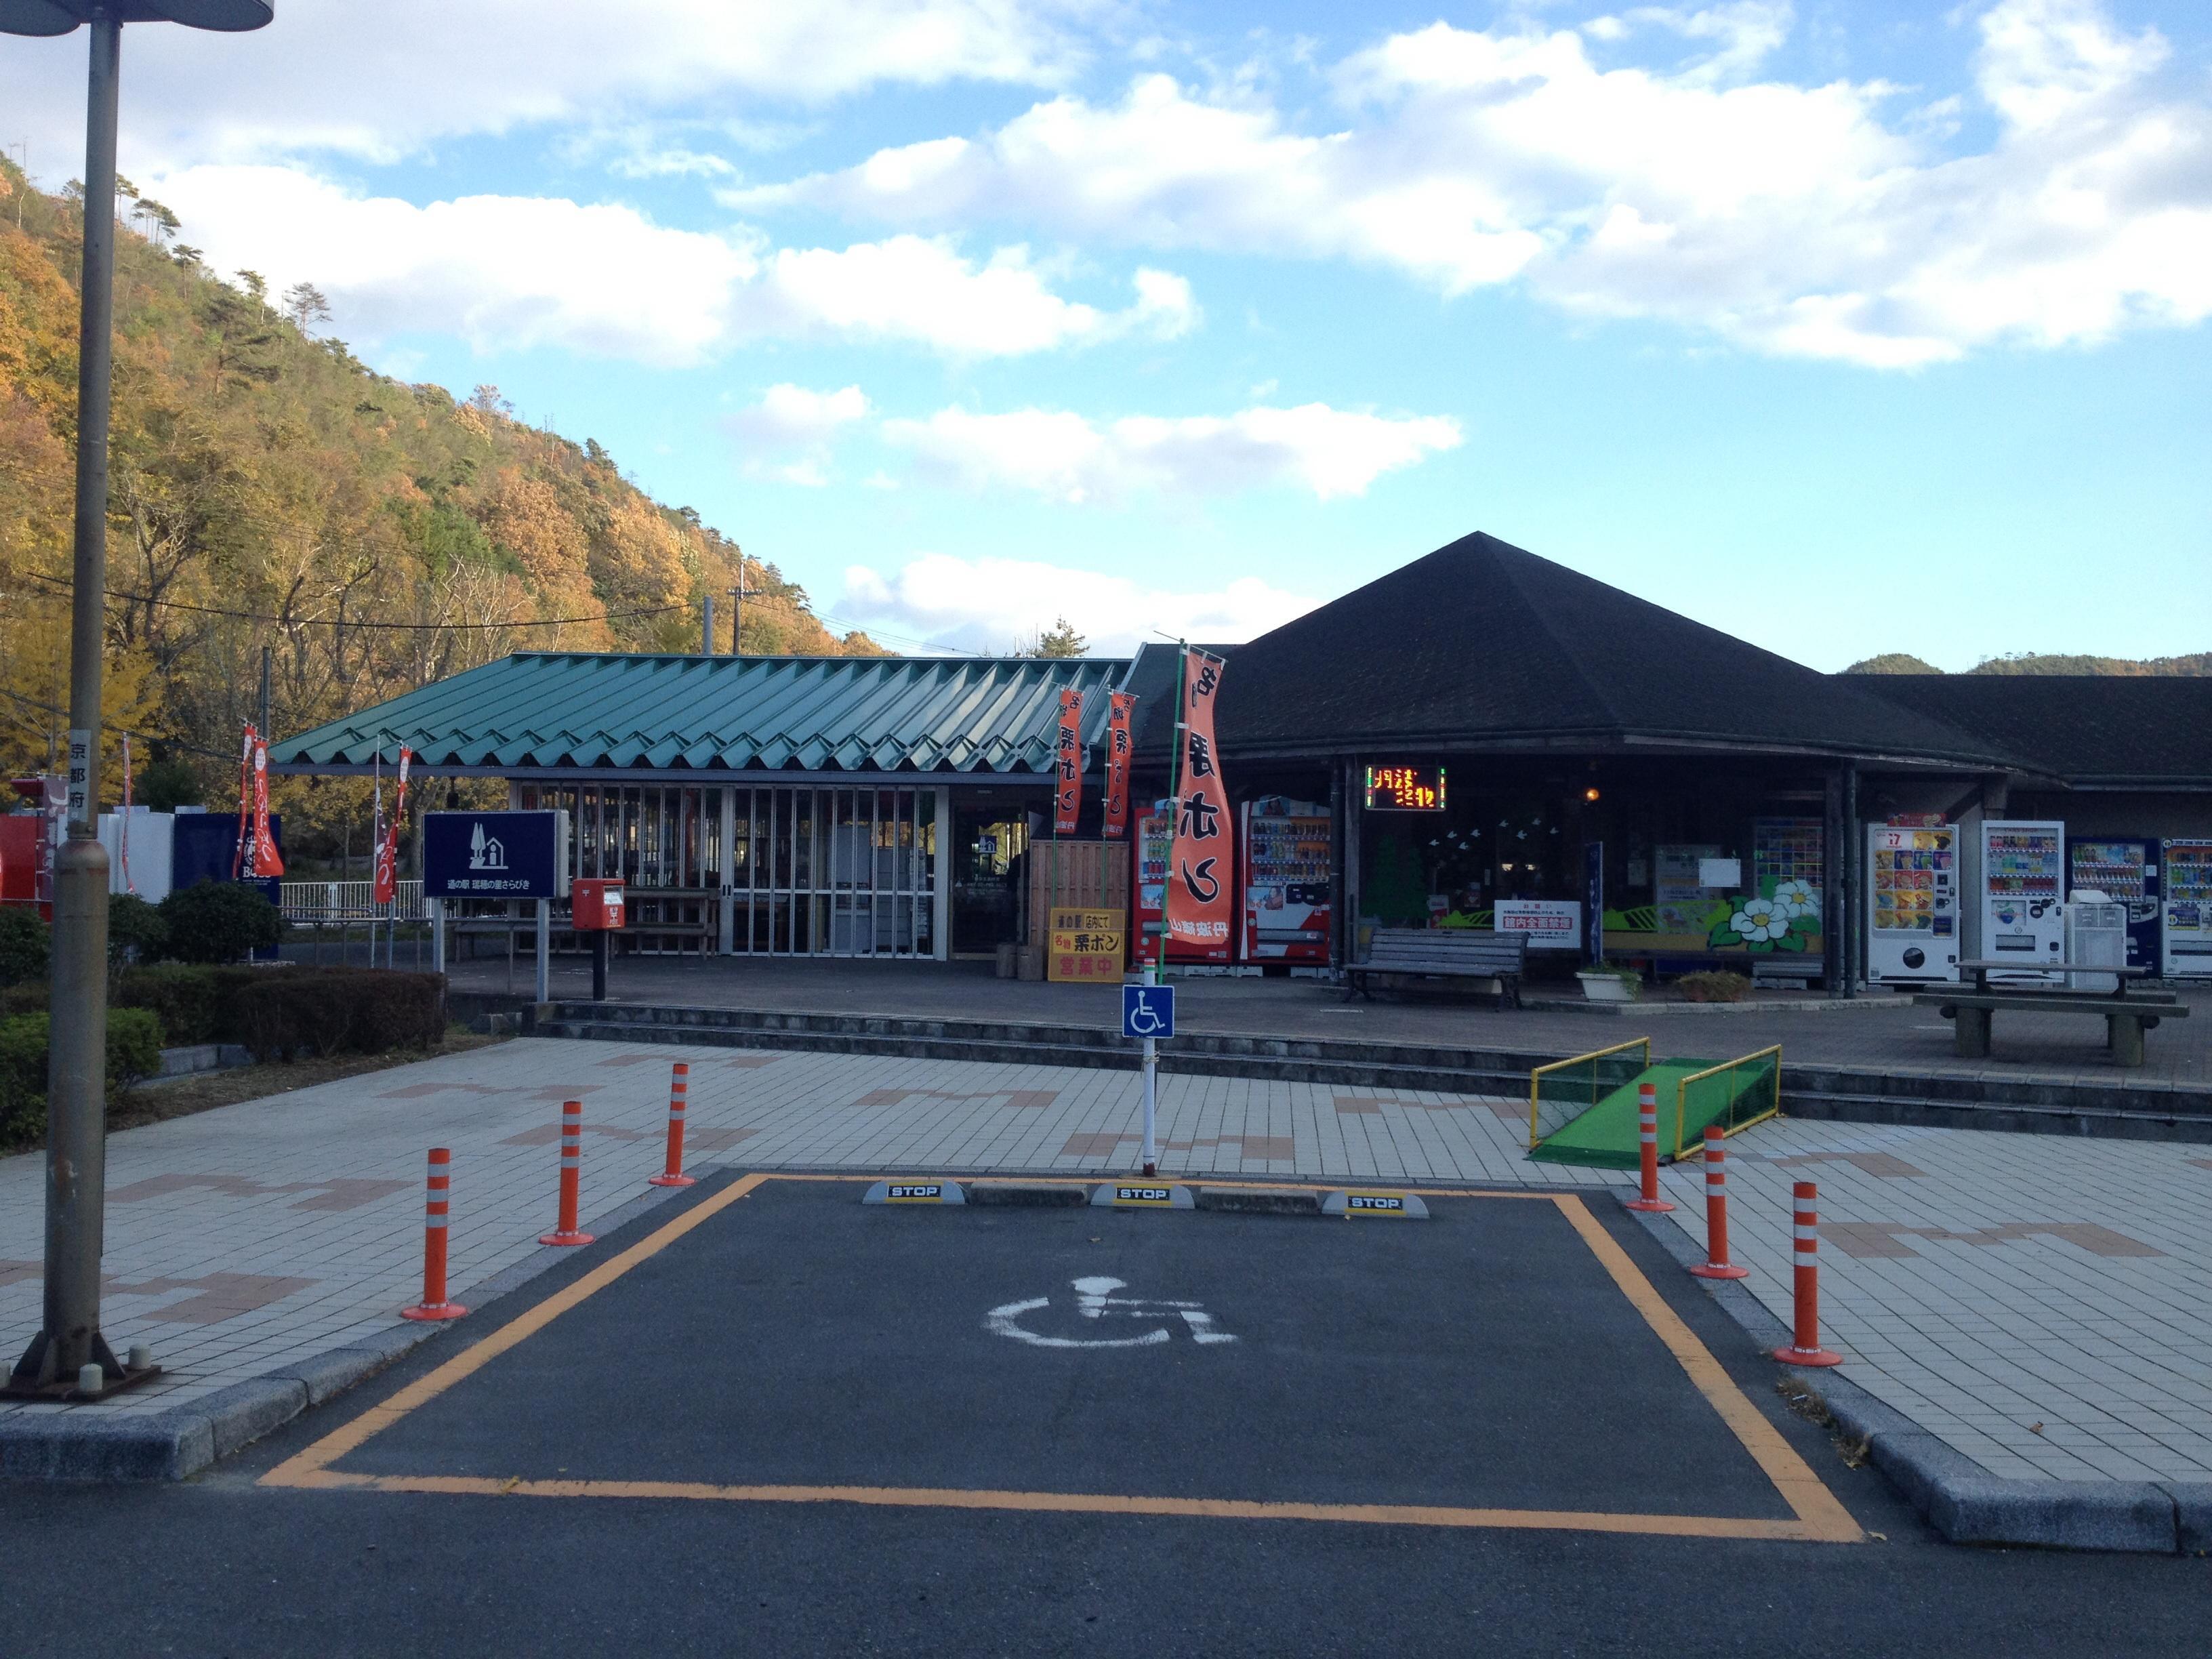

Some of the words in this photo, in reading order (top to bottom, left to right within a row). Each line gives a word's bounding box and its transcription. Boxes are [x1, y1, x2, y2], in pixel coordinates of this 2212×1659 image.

[70, 743, 87, 808] 京都府
[447, 879, 470, 889] 道の駅
[1058, 914, 1082, 928] 道の駅
[1085, 915, 1109, 928] 店内にて
[1074, 933, 1119, 952] 栗ポン
[1060, 956, 1112, 976] 営業中
[892, 1187, 937, 1196] STOP
[1120, 1189, 1166, 1199] STOP
[1352, 1197, 1399, 1208] STOP
